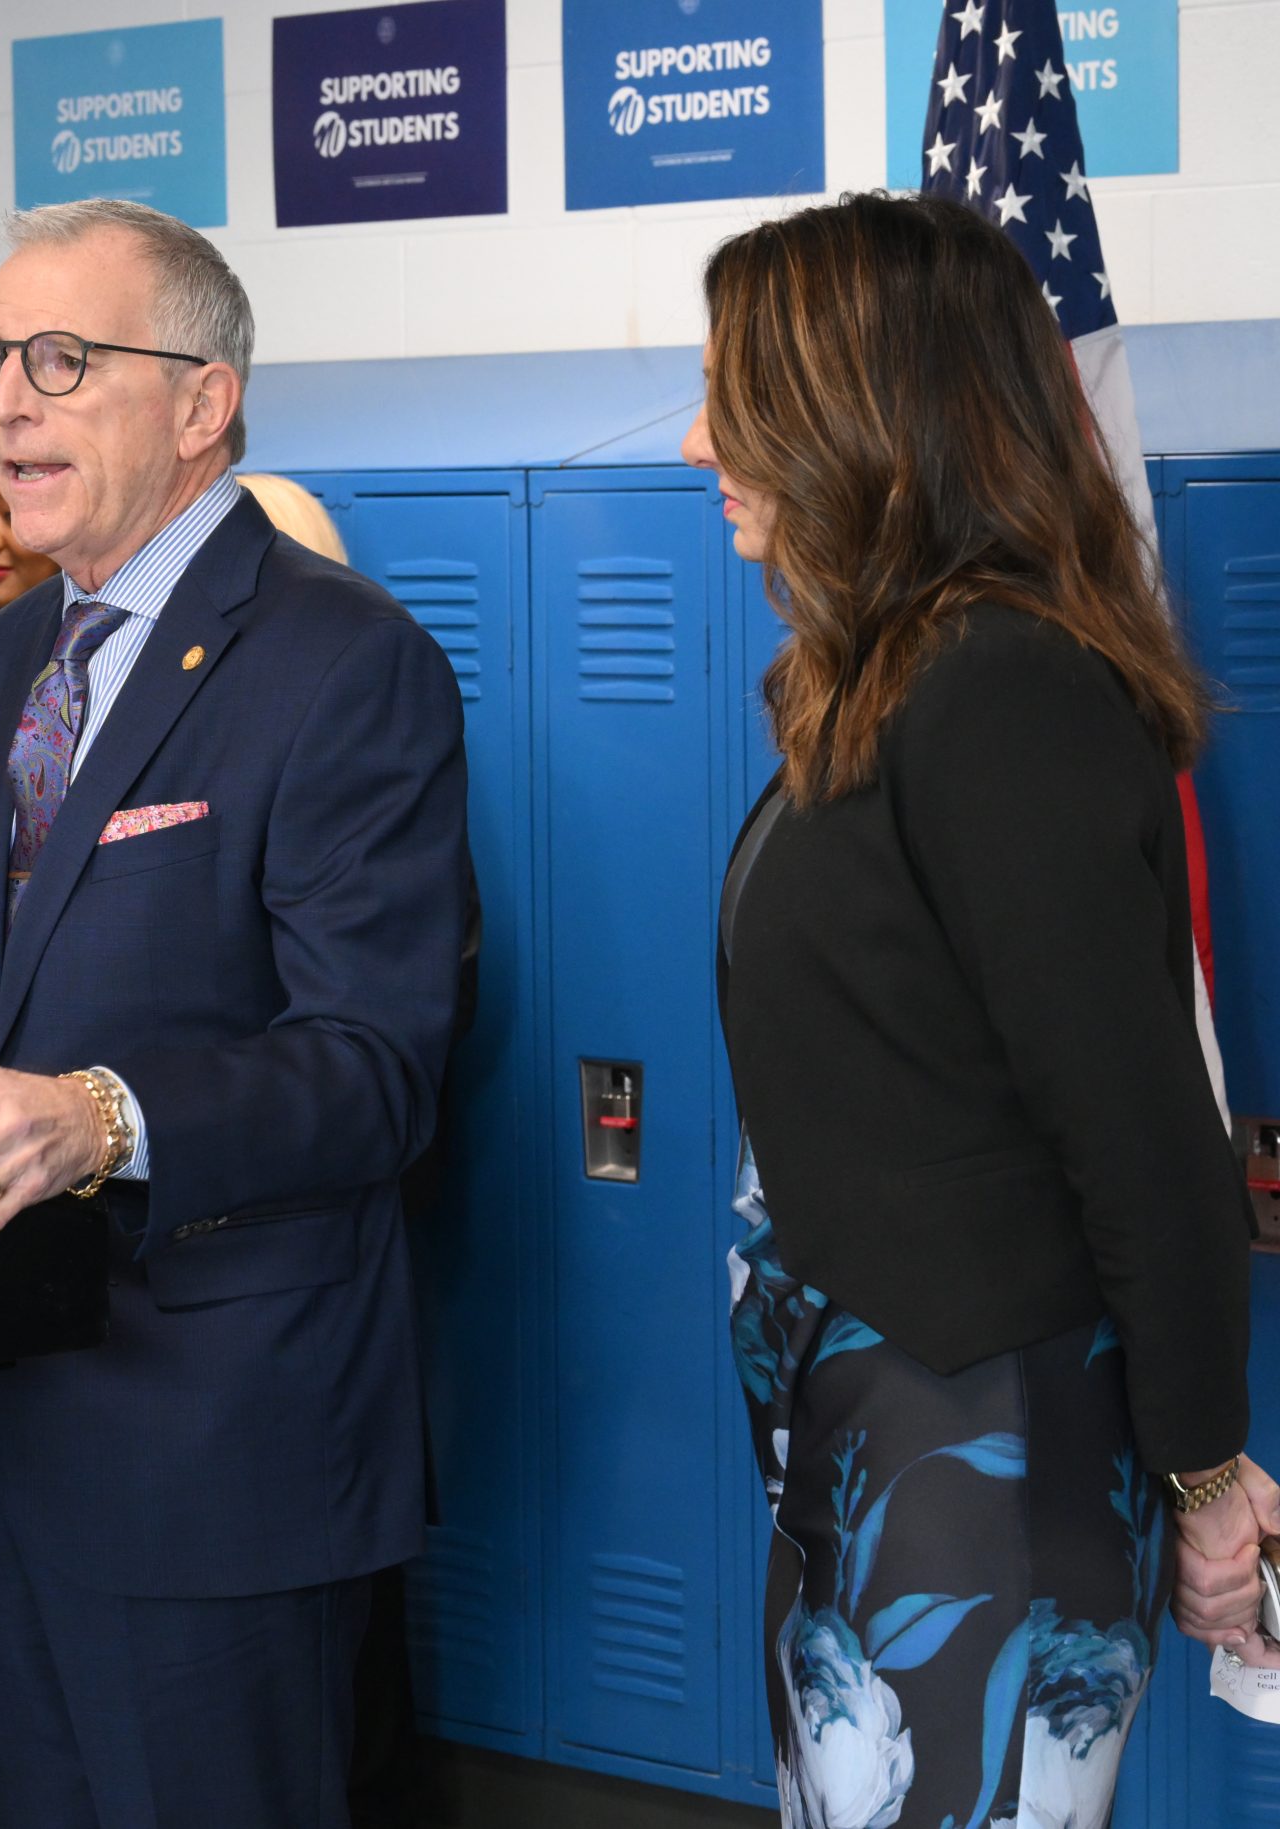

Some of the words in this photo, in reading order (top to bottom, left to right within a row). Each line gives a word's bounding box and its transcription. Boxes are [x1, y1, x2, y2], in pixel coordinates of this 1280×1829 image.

[615, 37, 772, 81] SUPPORTING
[57, 86, 183, 124] SUPPORTING
[319, 66, 461, 106] SUPPORTING
[646, 84, 770, 125] STUDENTS
[82, 129, 183, 164] STUDENTS
[347, 111, 460, 148] STUDENTS
[1257, 1672, 1277, 1680] cell
